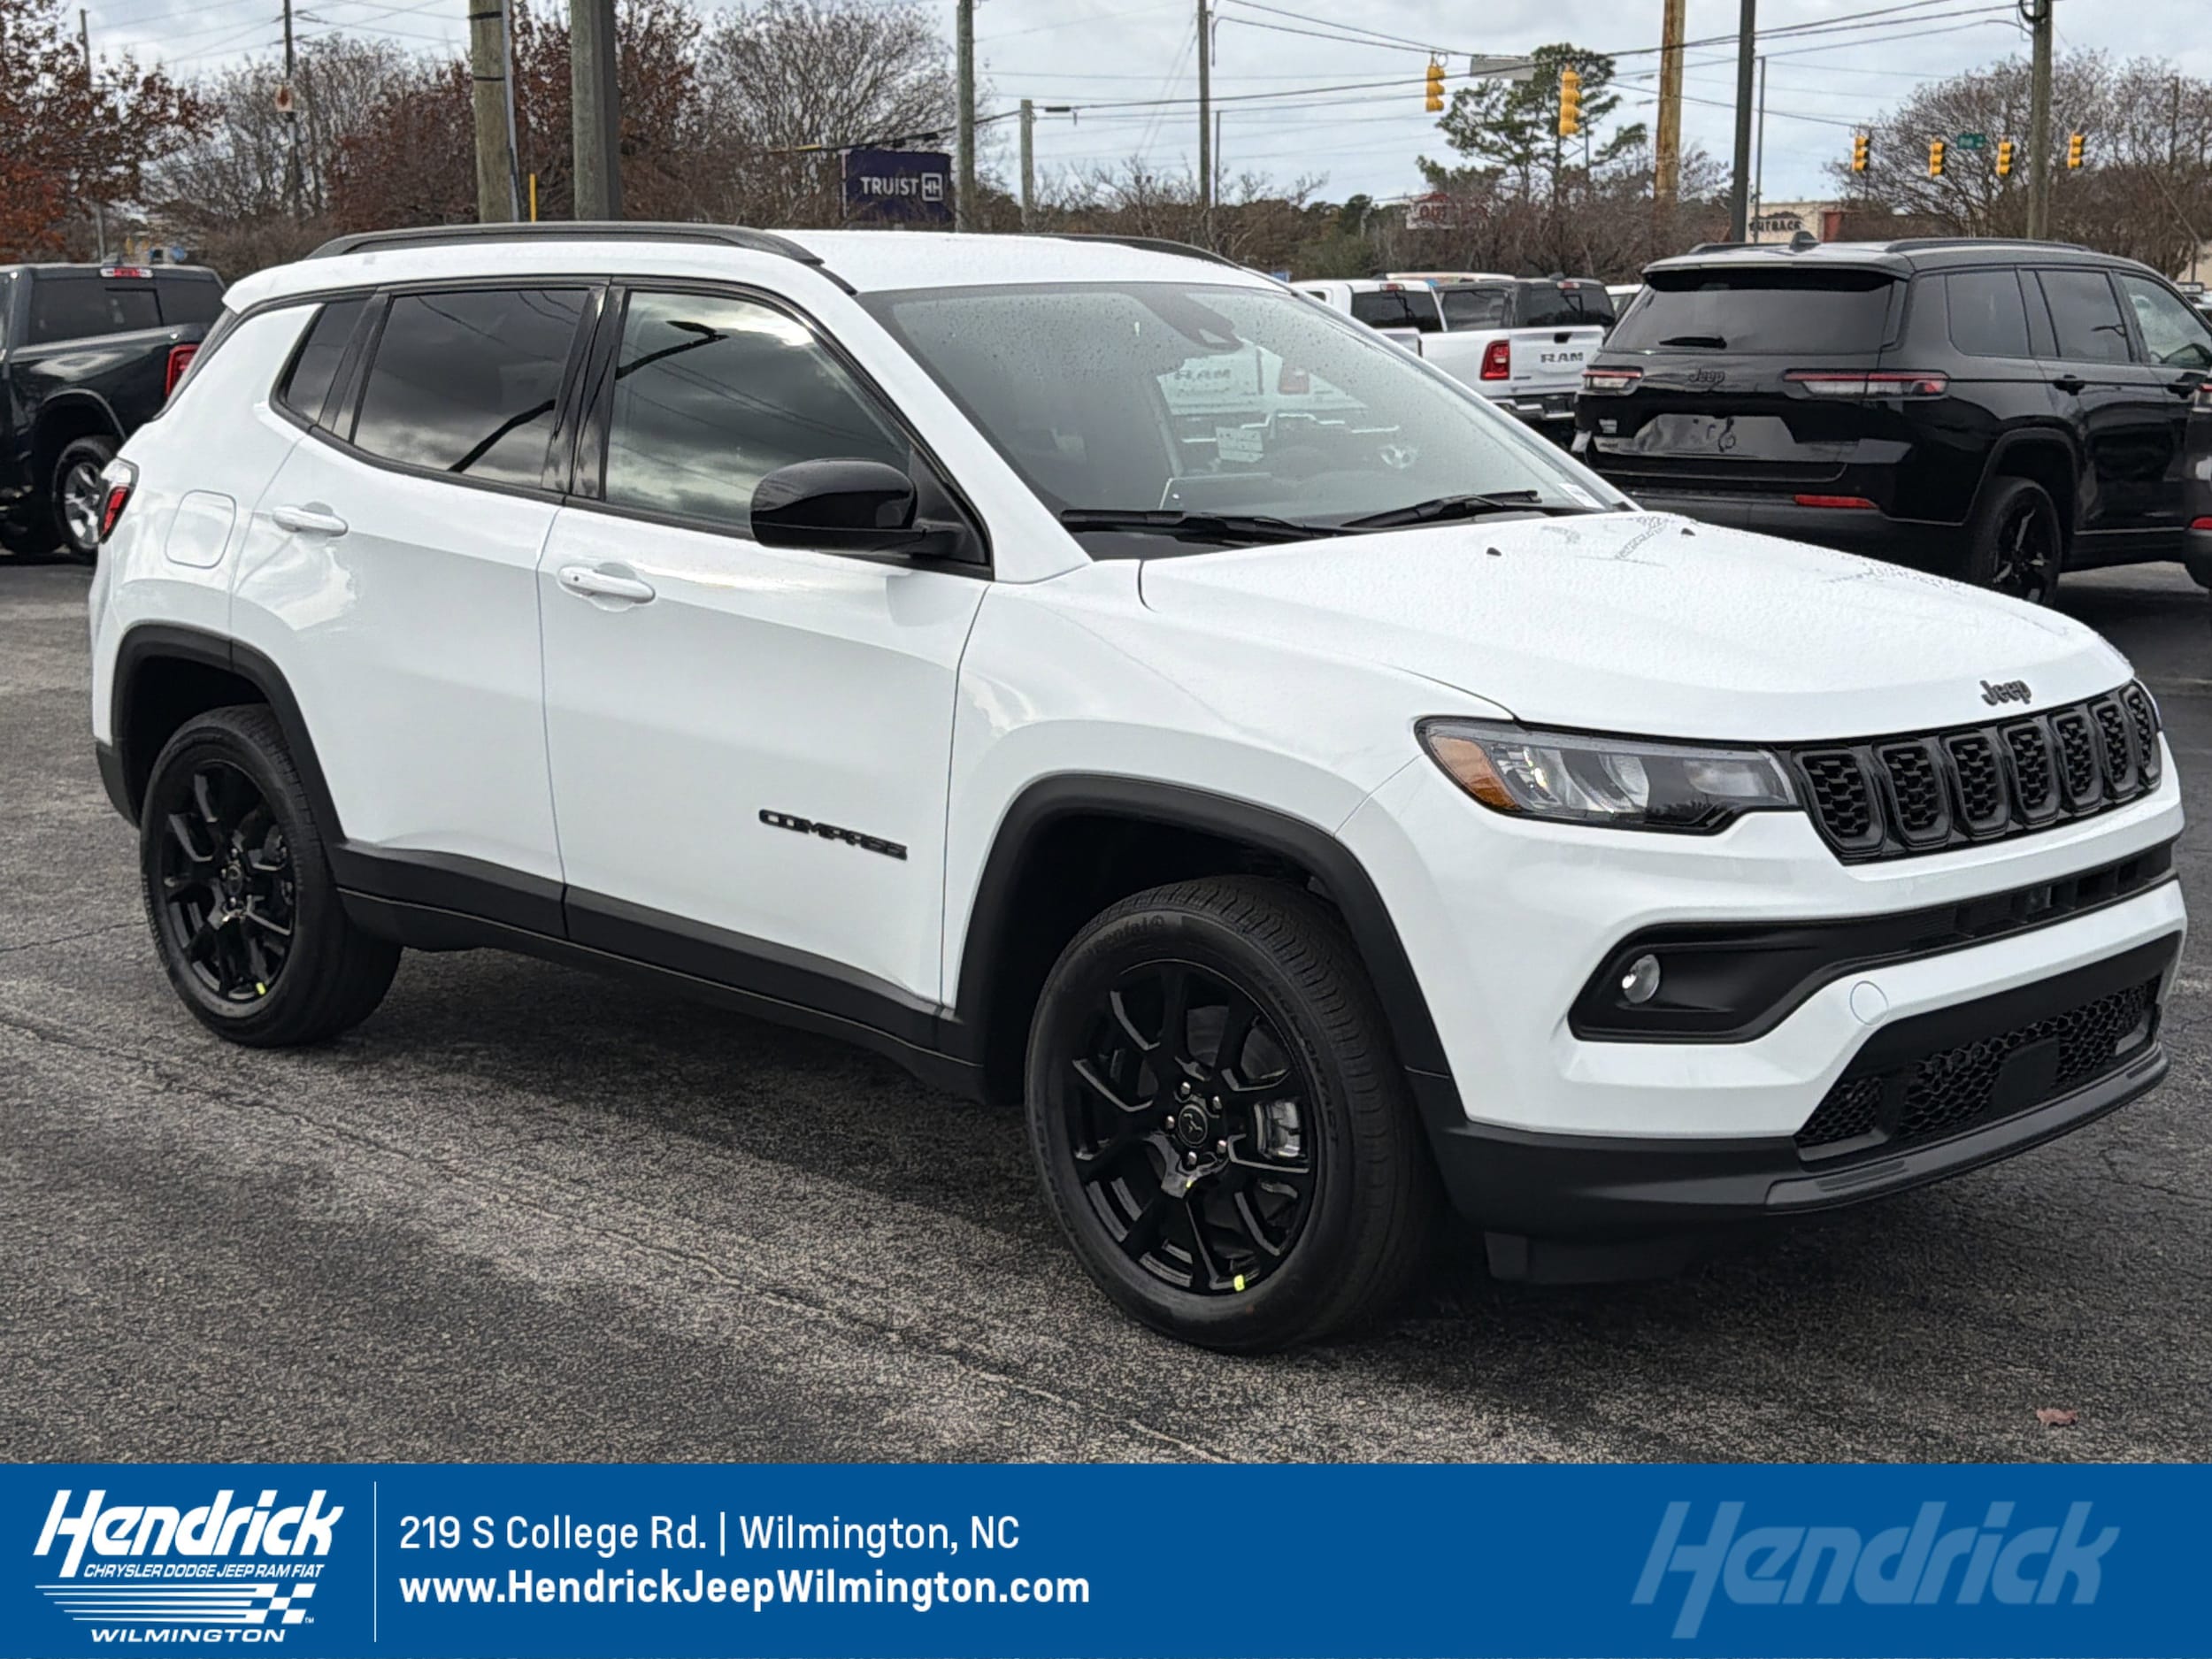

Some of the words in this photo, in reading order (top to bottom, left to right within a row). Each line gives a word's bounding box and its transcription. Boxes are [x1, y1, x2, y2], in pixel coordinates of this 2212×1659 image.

[860, 177, 919, 195] TRUIST
[1540, 352, 1583, 363] RAM
[1688, 368, 1725, 382] Jeep
[1979, 680, 2032, 705] Jeep
[759, 809, 908, 861] COMPASS
